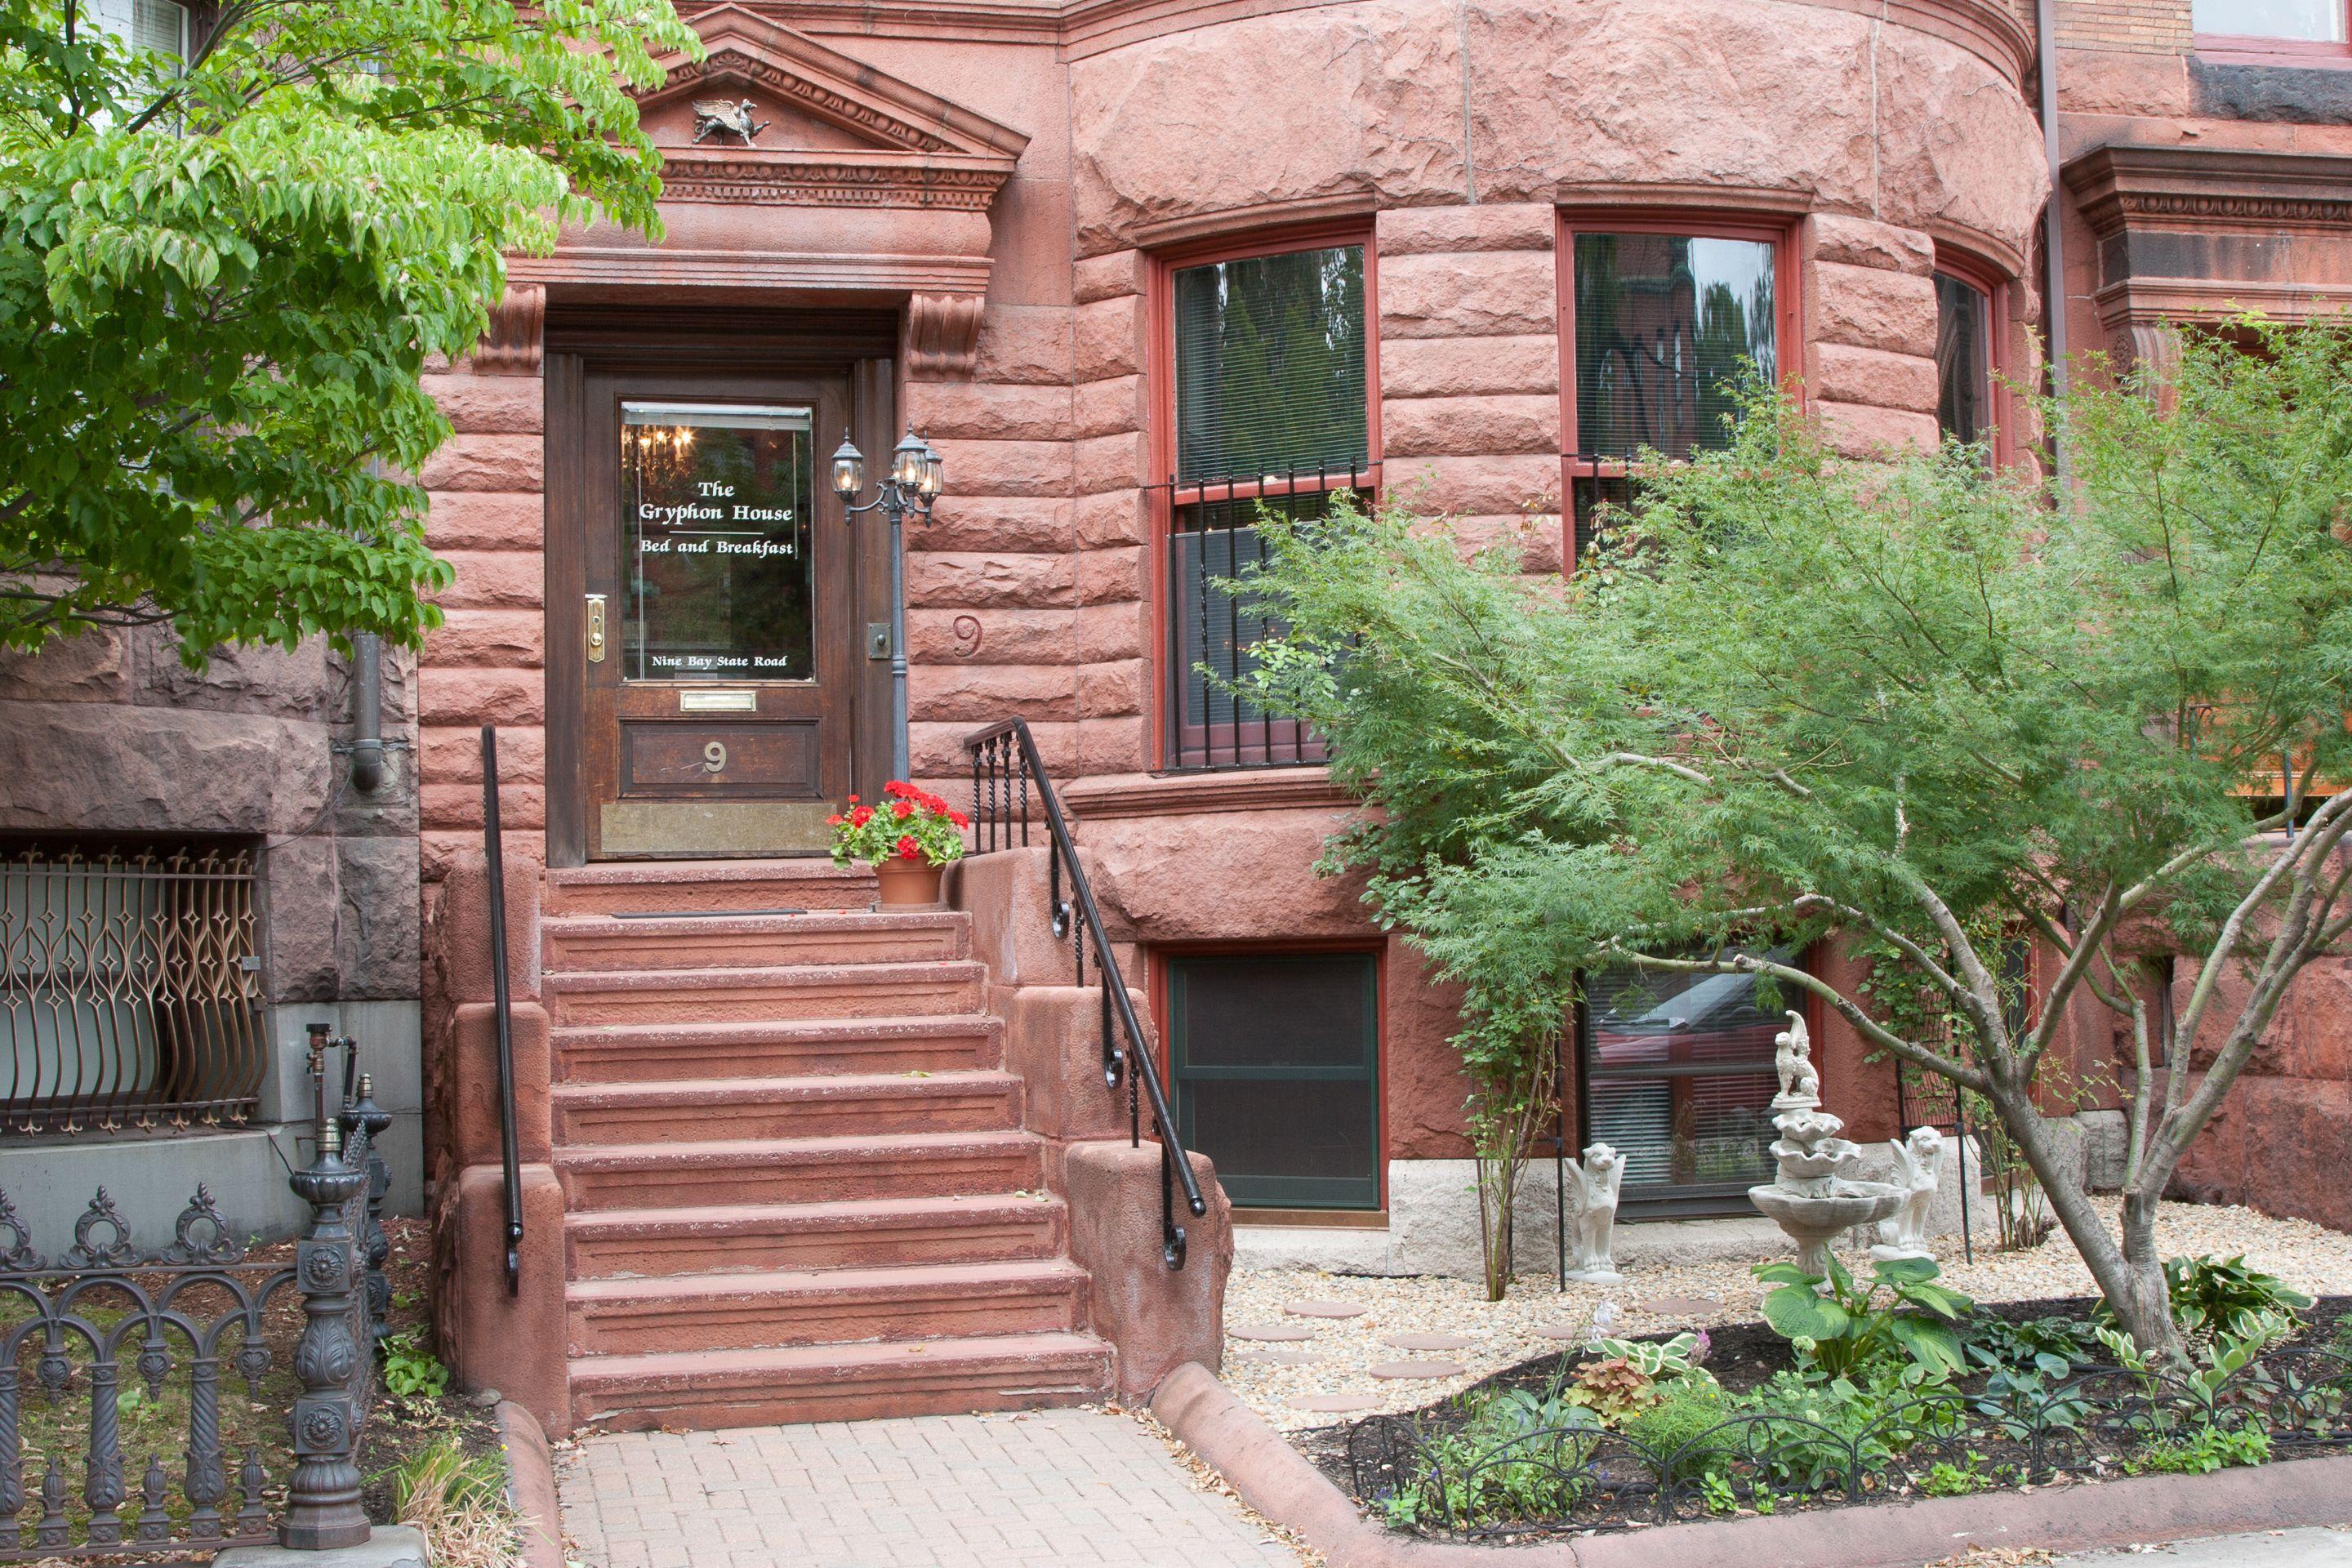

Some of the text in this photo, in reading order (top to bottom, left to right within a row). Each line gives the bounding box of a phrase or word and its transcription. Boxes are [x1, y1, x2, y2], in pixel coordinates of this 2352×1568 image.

[697, 480, 735, 497] The
[639, 502, 793, 525] Gryphon House
[640, 538, 793, 559] Bed and Breakfast
[953, 615, 982, 657] 9
[652, 655, 788, 670] Nine Bay State Road
[704, 742, 728, 773] 9
